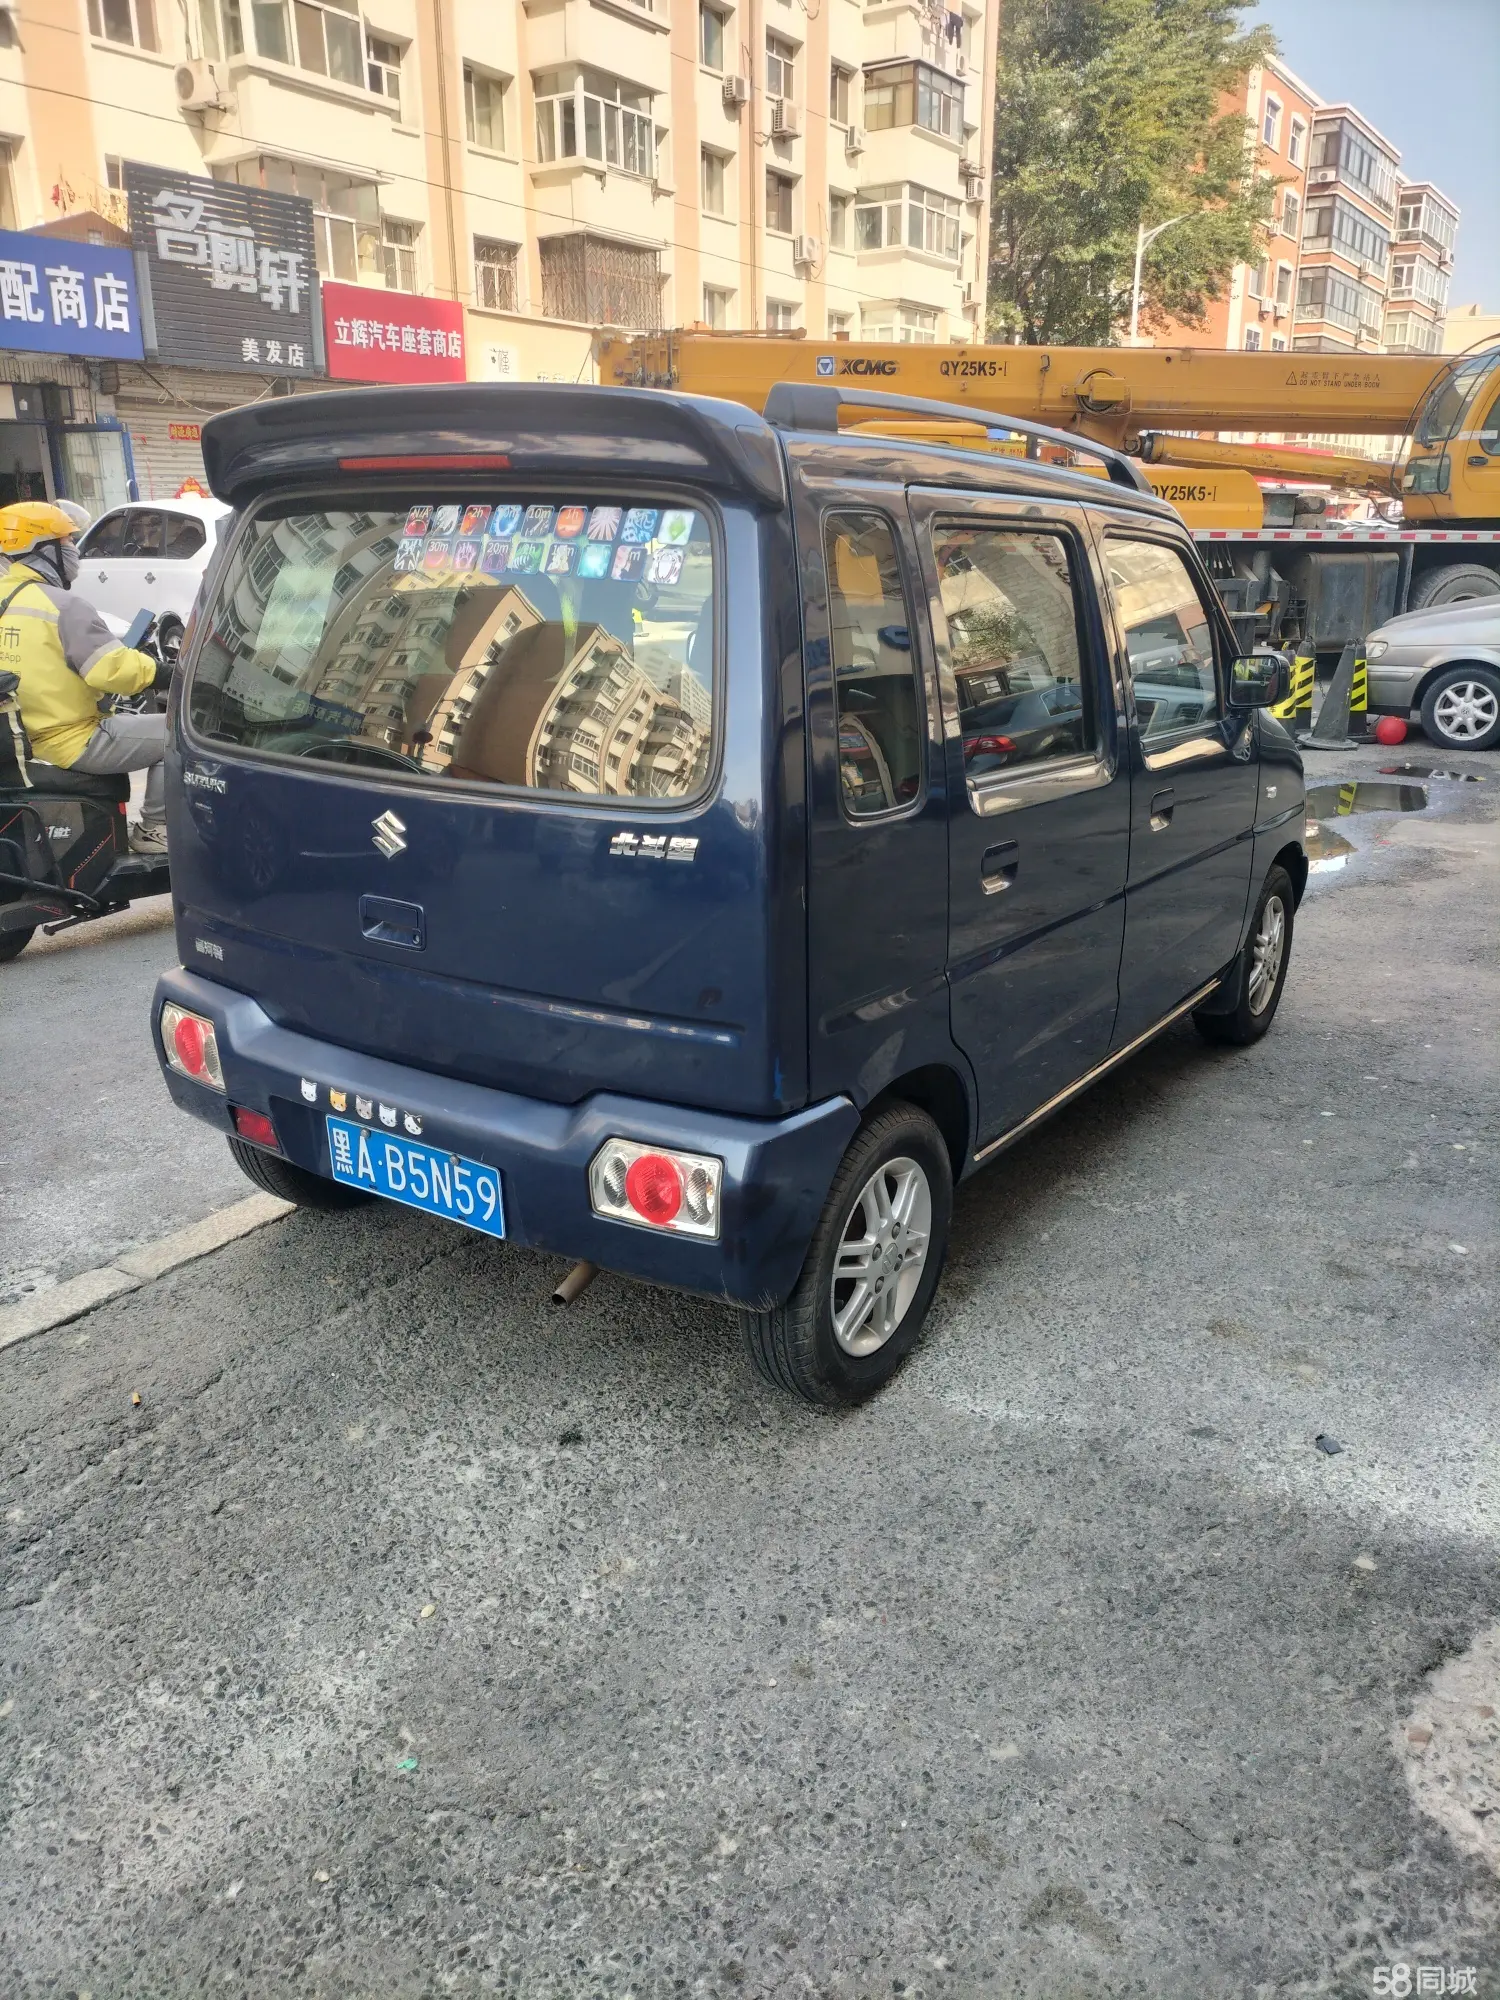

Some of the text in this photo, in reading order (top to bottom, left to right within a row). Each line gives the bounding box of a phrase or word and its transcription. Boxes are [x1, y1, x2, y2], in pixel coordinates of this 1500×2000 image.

[152, 190, 309, 313] 名剪轩
[0, 260, 131, 333] 配商店
[334, 317, 462, 359] 立辉汽车座套商店
[241, 337, 304, 368] 美发店
[839, 358, 897, 377] XCMG
[1299, 379, 1308, 387] DO
[1310, 379, 1322, 387] NOT
[1324, 380, 1342, 388] STAND
[1365, 381, 1381, 389] BOOM
[529, 508, 552, 519] 10m
[429, 542, 449, 552] 30m
[487, 543, 509, 554] 20m
[183, 771, 227, 795] SUZUKI
[609, 832, 699, 861] 北斗星
